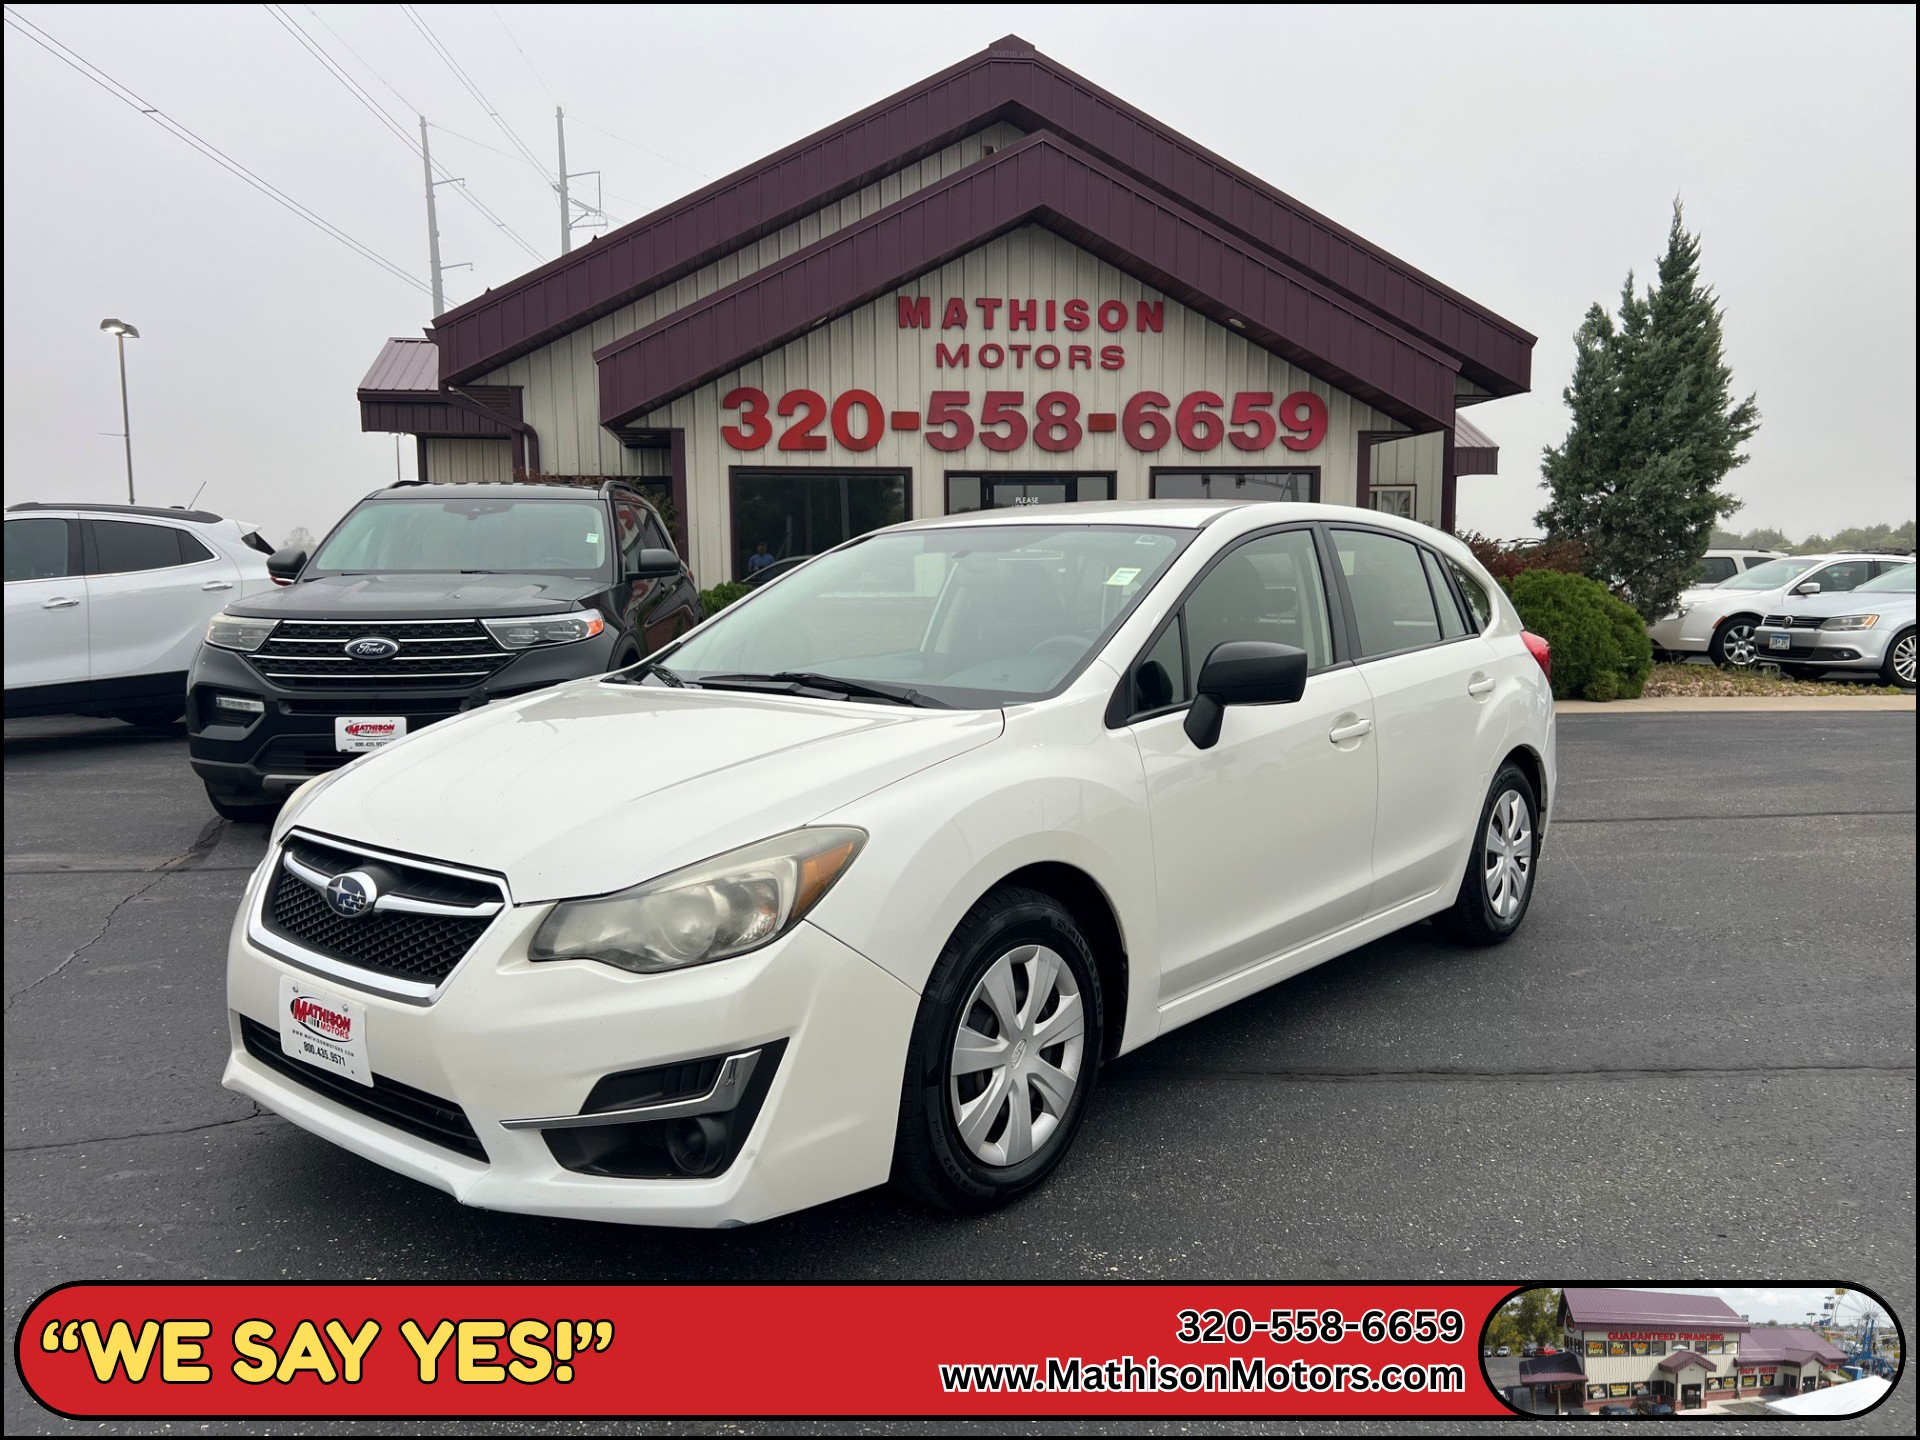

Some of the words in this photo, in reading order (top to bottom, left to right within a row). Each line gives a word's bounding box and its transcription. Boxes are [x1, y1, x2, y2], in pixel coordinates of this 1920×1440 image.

[898, 296, 1164, 332] MATHISON
[935, 343, 1125, 370] MOTORS
[721, 387, 1328, 451] 320-558-6659
[356, 642, 386, 654] Ford
[348, 724, 395, 734] MATHISON
[293, 998, 351, 1033] MATHISON
[320, 1021, 349, 1040] MOTORS
[303, 1041, 346, 1067] 800.435.9571
